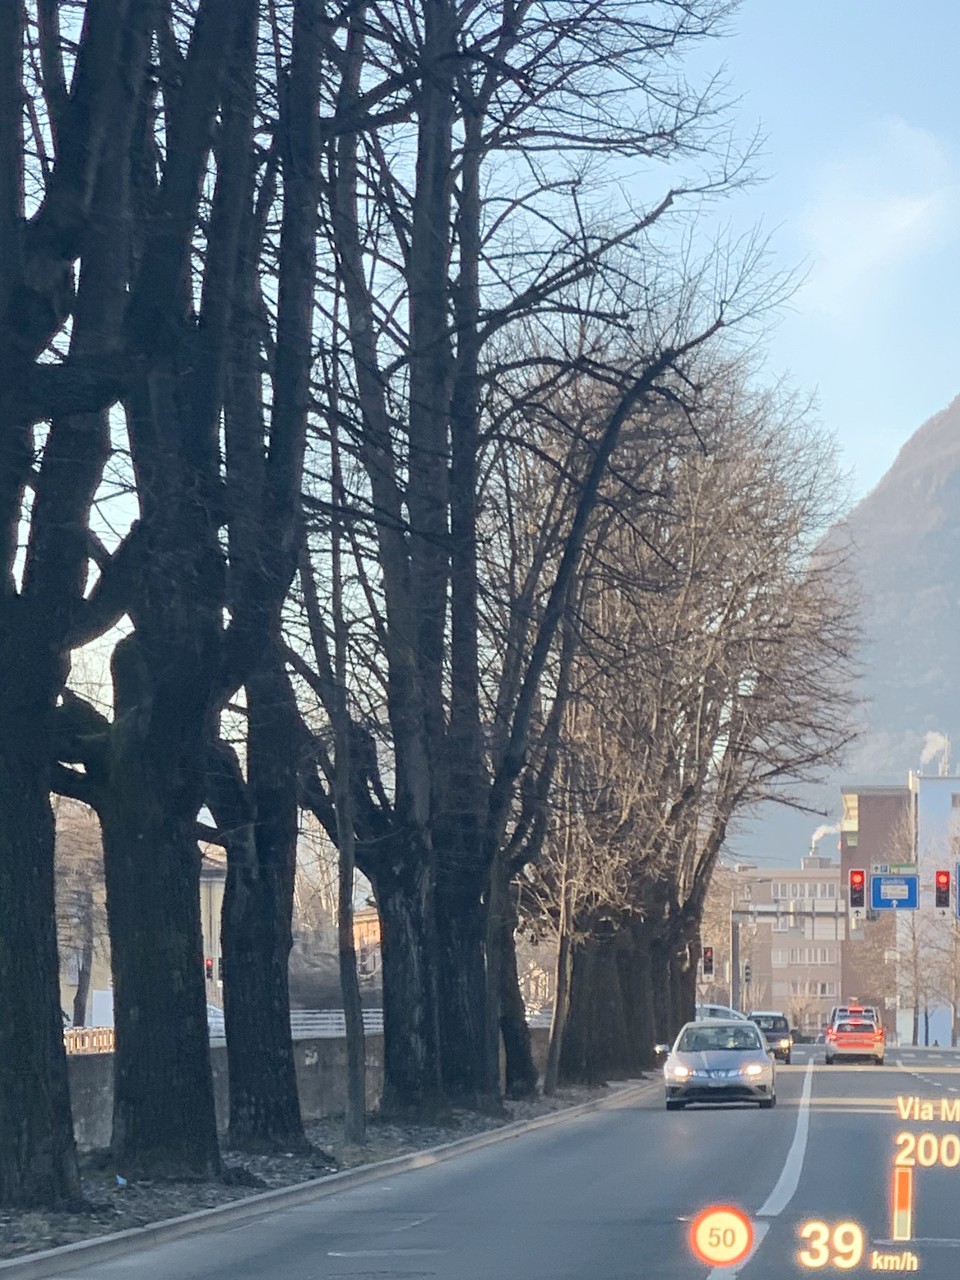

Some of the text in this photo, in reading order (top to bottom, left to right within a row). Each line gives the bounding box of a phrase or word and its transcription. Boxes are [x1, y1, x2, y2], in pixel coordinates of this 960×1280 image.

[897, 1096, 934, 1121] Via
[708, 1228, 736, 1248] 50
[800, 1221, 918, 1271] 39 km/h
